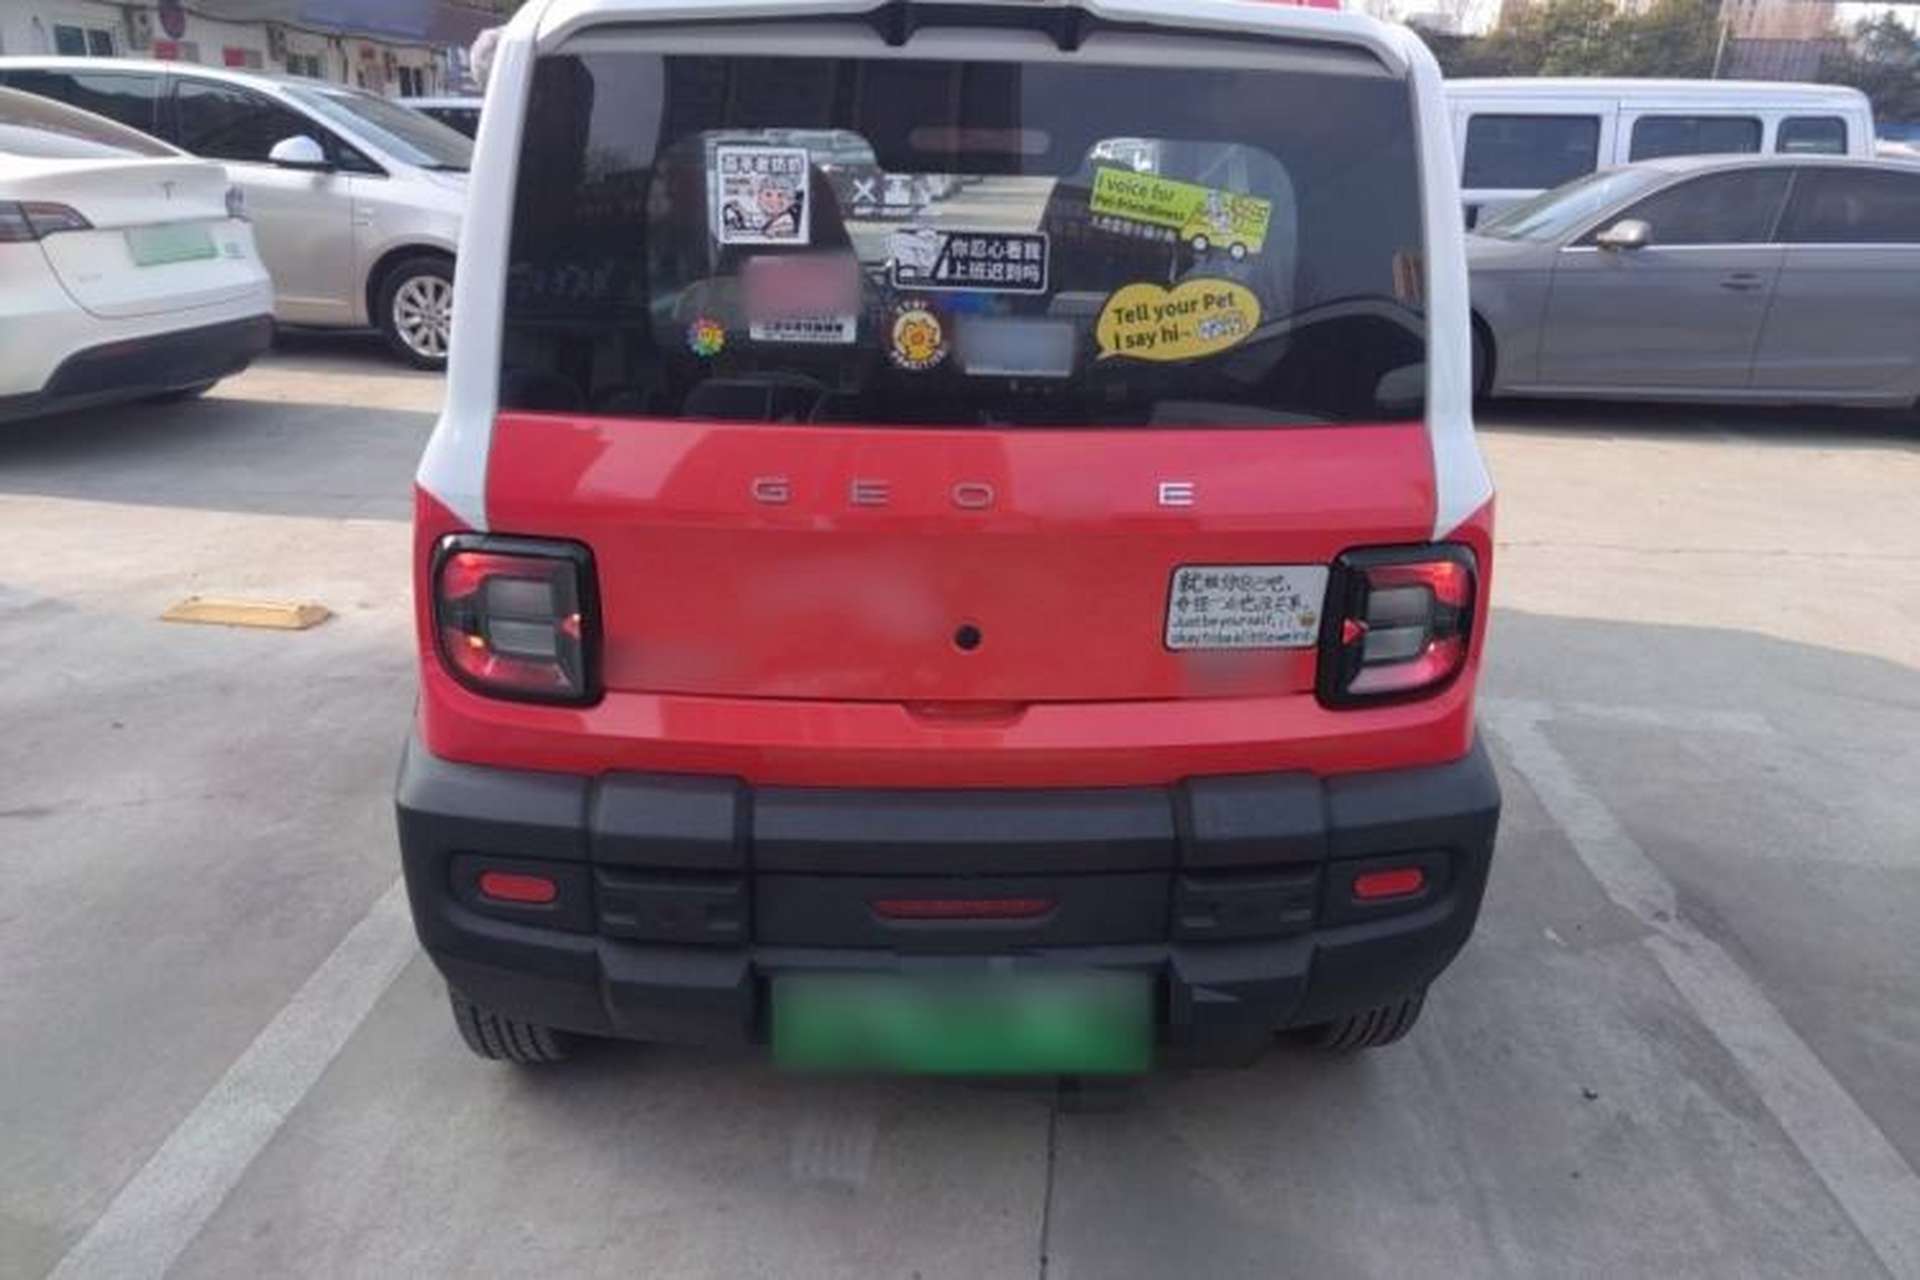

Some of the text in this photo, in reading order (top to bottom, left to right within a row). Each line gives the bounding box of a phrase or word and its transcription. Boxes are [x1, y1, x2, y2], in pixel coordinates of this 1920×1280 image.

[951, 239, 1041, 261] 你忍心看我
[952, 260, 1040, 283] 上班迟到吗
[1113, 292, 1235, 325] Tell your Pet
[1125, 329, 1156, 350] say
